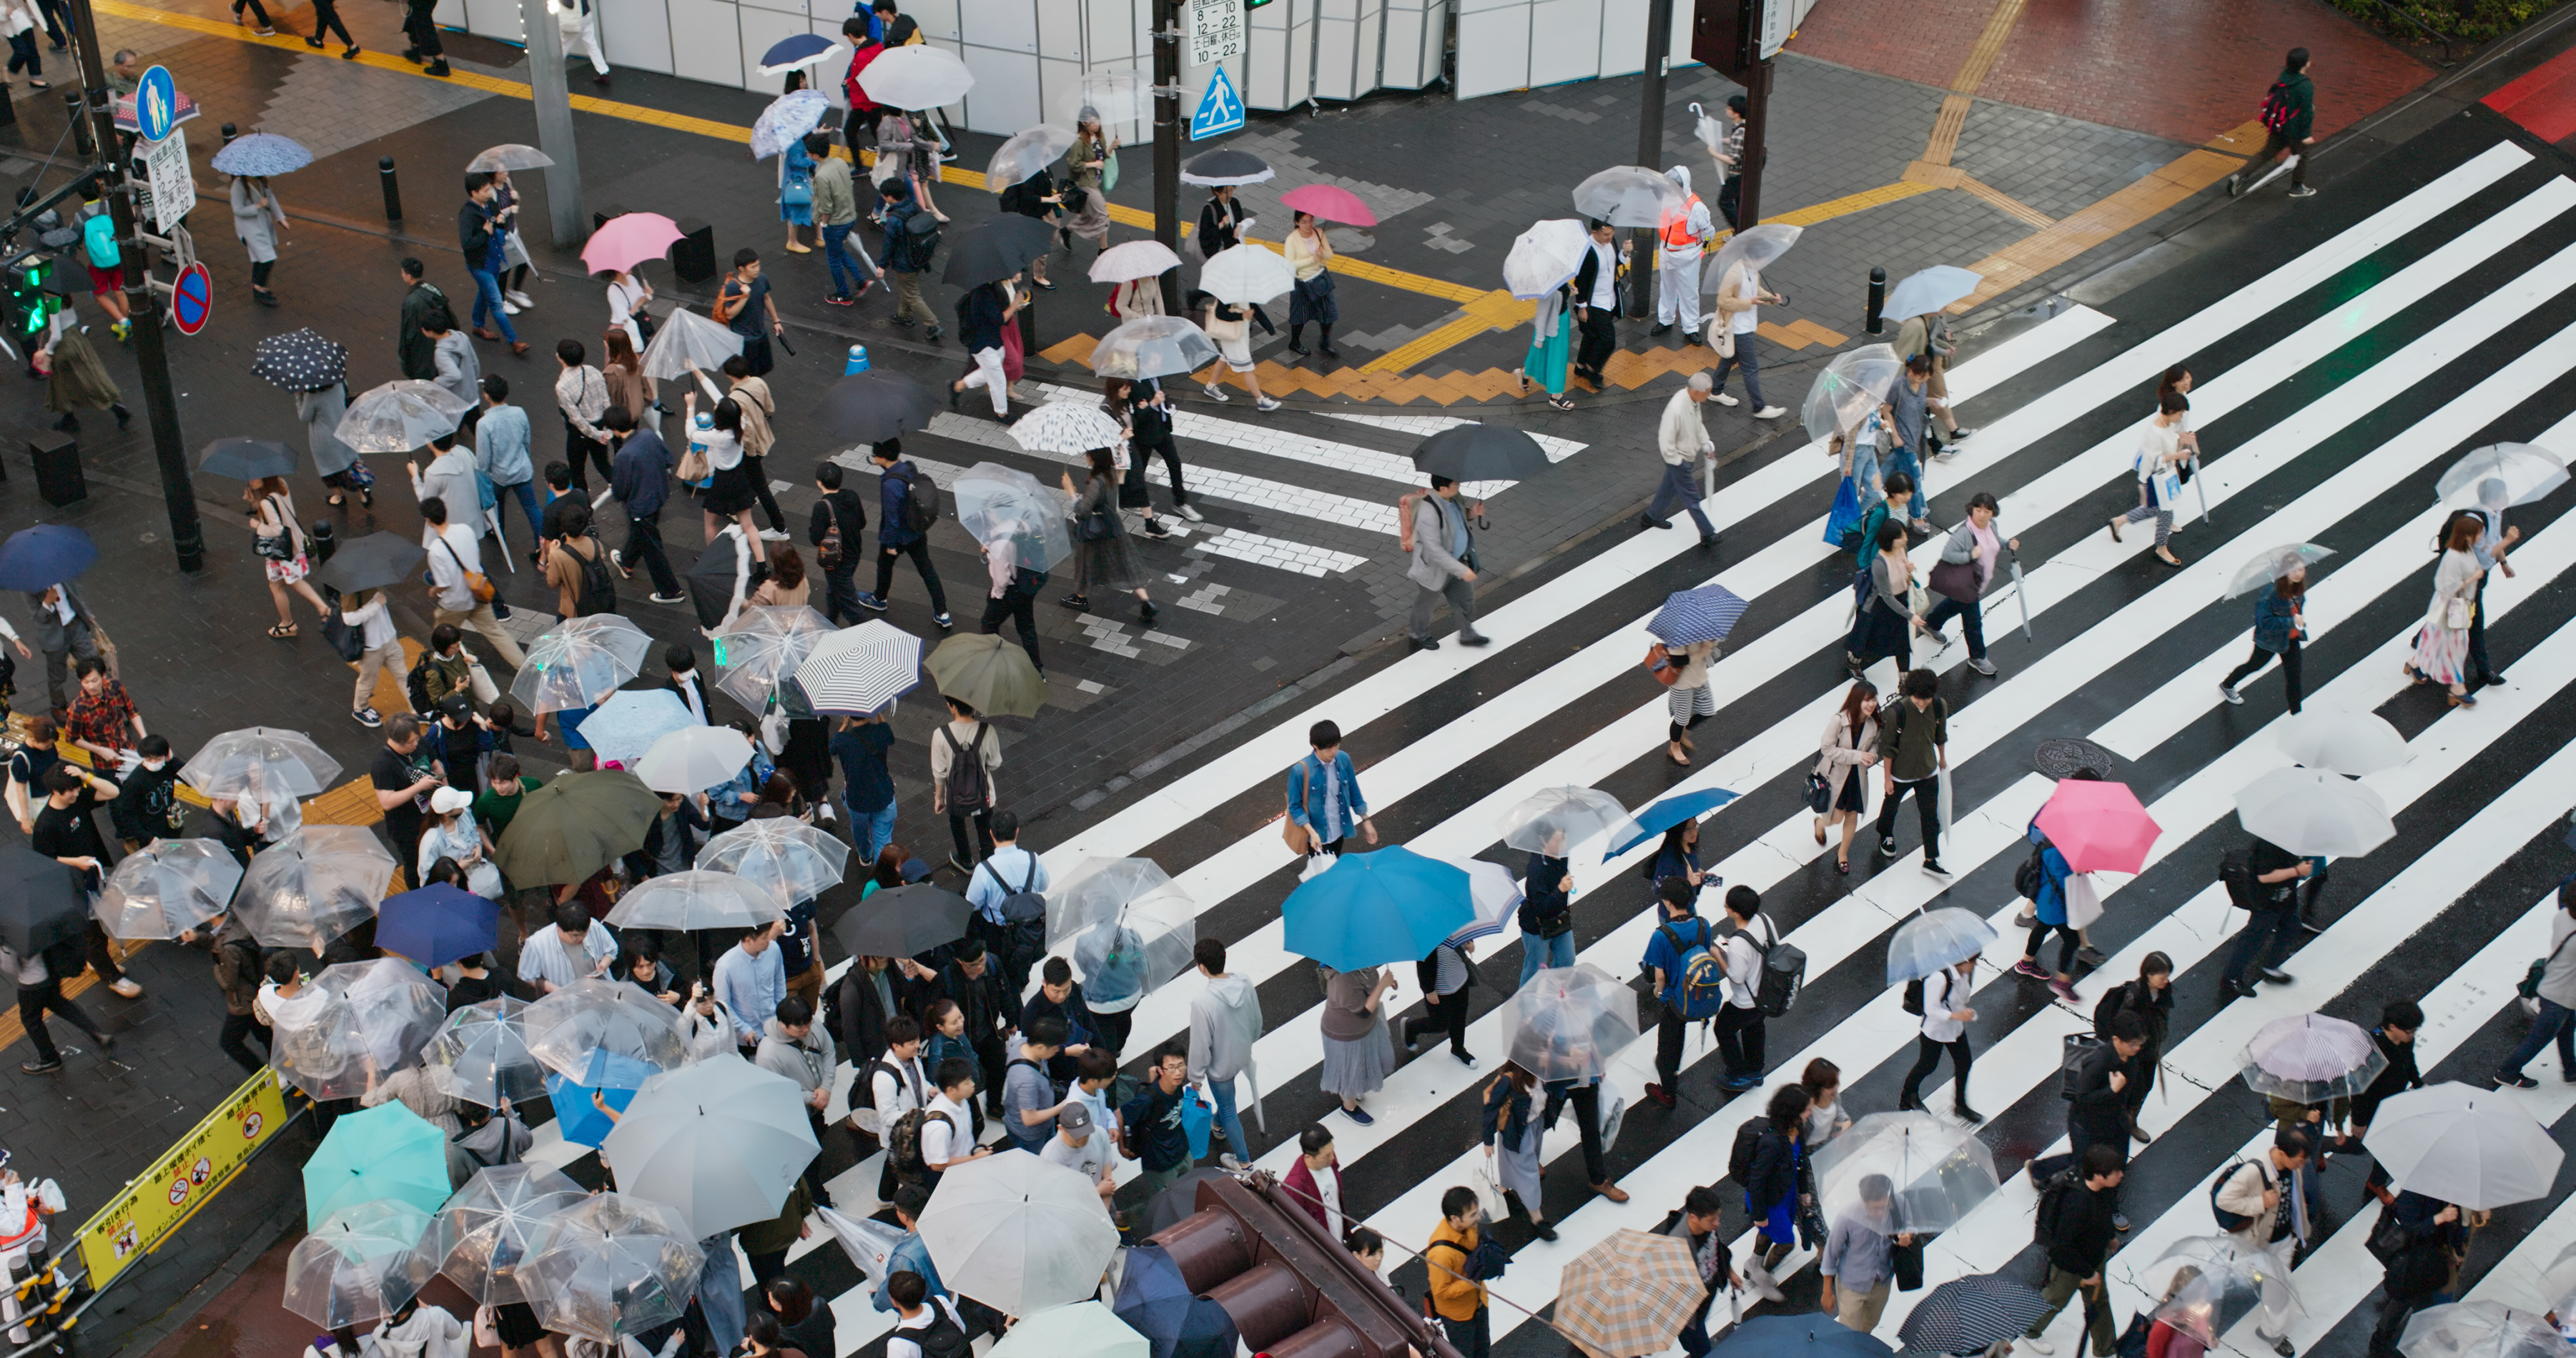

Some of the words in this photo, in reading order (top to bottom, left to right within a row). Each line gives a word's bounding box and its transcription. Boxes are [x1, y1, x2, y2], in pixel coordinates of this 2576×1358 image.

[1198, 10, 1204, 21] 8
[1225, 1, 1235, 14] 10
[1198, 23, 1208, 36] 12
[1222, 15, 1235, 29] 22
[1198, 50, 1208, 63] 10
[1223, 43, 1237, 56] 22
[149, 137, 182, 169] 自転車を除く
[156, 169, 161, 180] 8
[173, 150, 182, 166] 10
[158, 182, 167, 197] 12
[174, 166, 184, 183] 22
[163, 212, 172, 227] 10
[179, 196, 190, 214] 22
